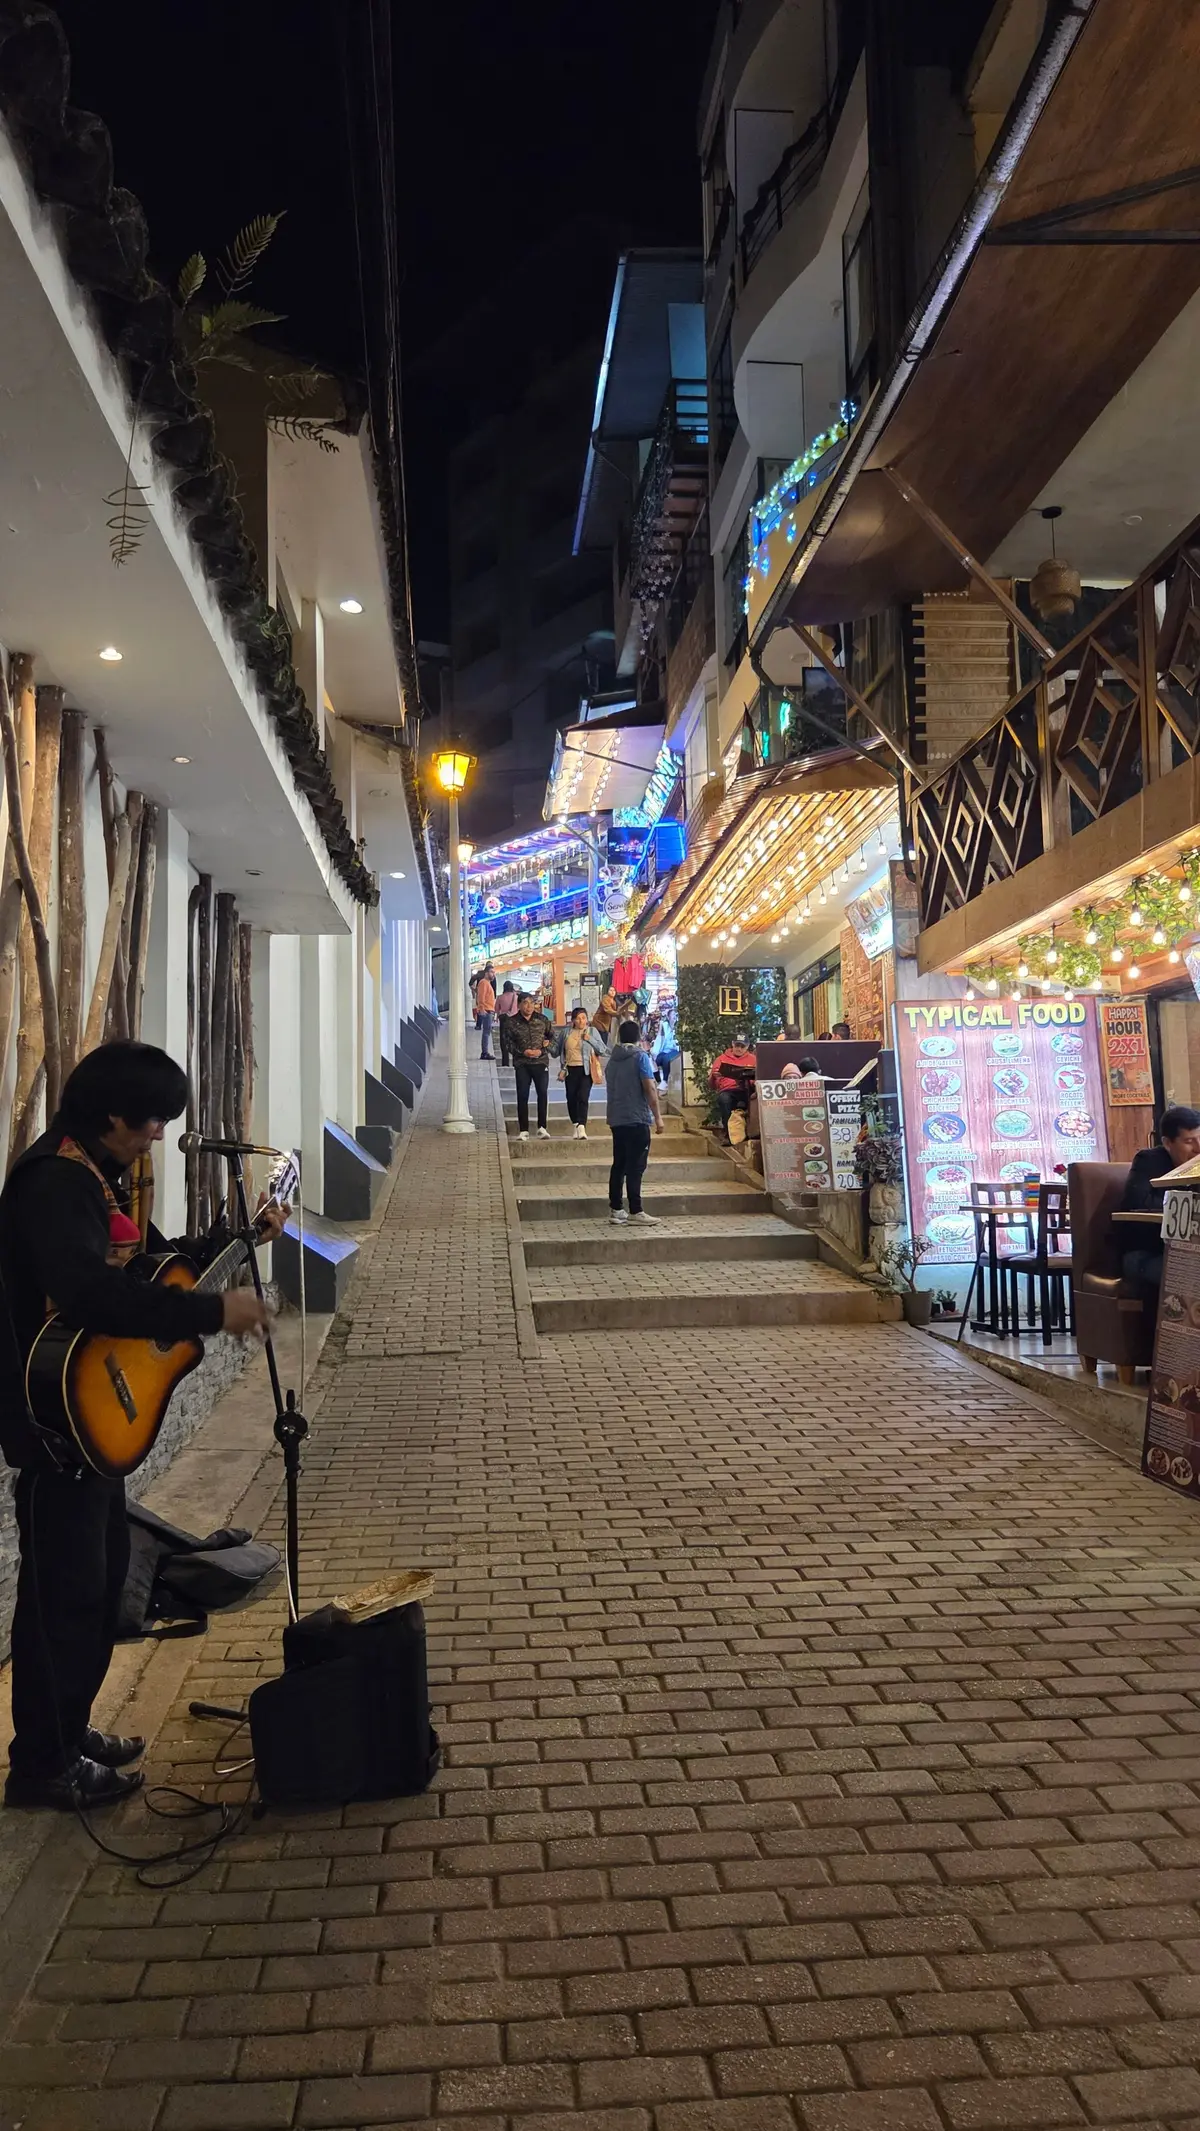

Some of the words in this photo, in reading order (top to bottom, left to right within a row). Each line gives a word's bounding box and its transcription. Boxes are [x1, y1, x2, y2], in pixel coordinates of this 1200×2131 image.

[723, 988, 743, 1012] H
[904, 1004, 1012, 1030] TYPICAL
[1018, 1002, 1086, 1027] FOOD
[1108, 1007, 1138, 1020] HAPPY
[1106, 1021, 1142, 1036] HOUR
[987, 1058, 1006, 1066] CAUSA
[762, 1083, 787, 1100] 30
[795, 1090, 824, 1099] ANDINO
[831, 1127, 852, 1142] 38
[837, 1173, 854, 1188] 20
[1166, 1196, 1191, 1240] 30
